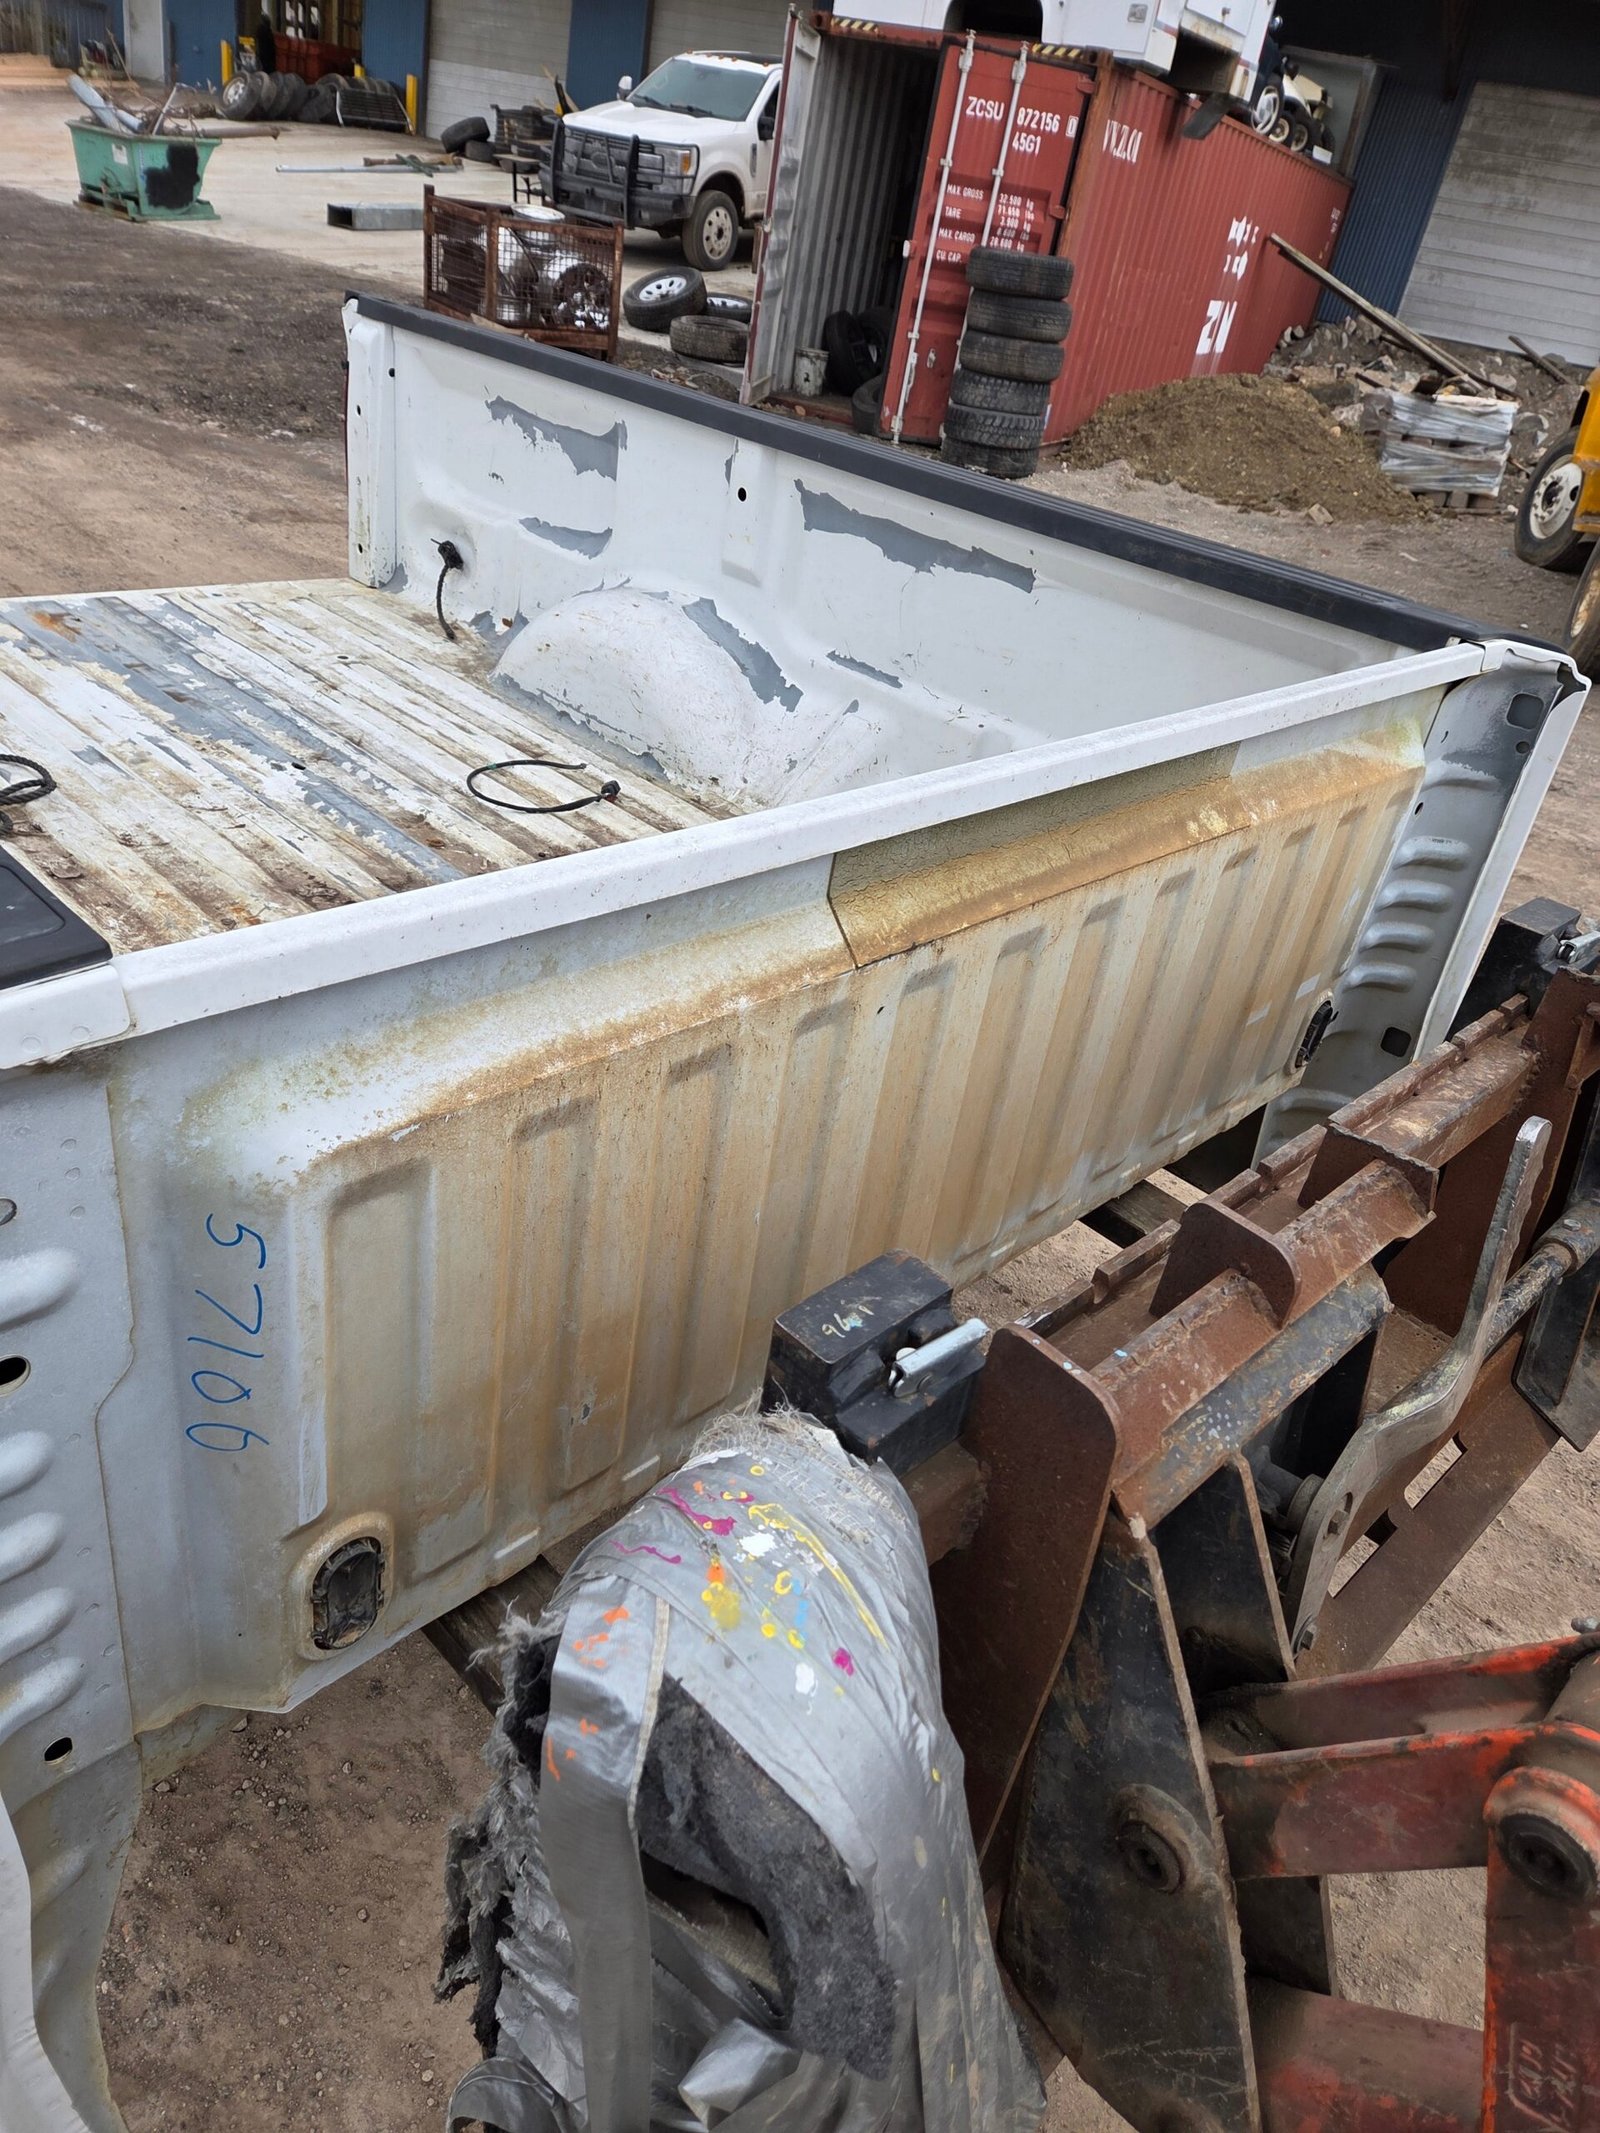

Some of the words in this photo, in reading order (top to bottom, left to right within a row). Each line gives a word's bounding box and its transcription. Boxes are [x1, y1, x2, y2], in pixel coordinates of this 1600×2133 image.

[965, 96, 1005, 121] ZCSU
[1017, 107, 1061, 133] 872156
[1012, 131, 1042, 155] 45G1
[963, 187, 984, 200] GROSS
[945, 206, 962, 219] TARE
[954, 231, 976, 243] CARGO
[186, 1213, 268, 1451] 57106
